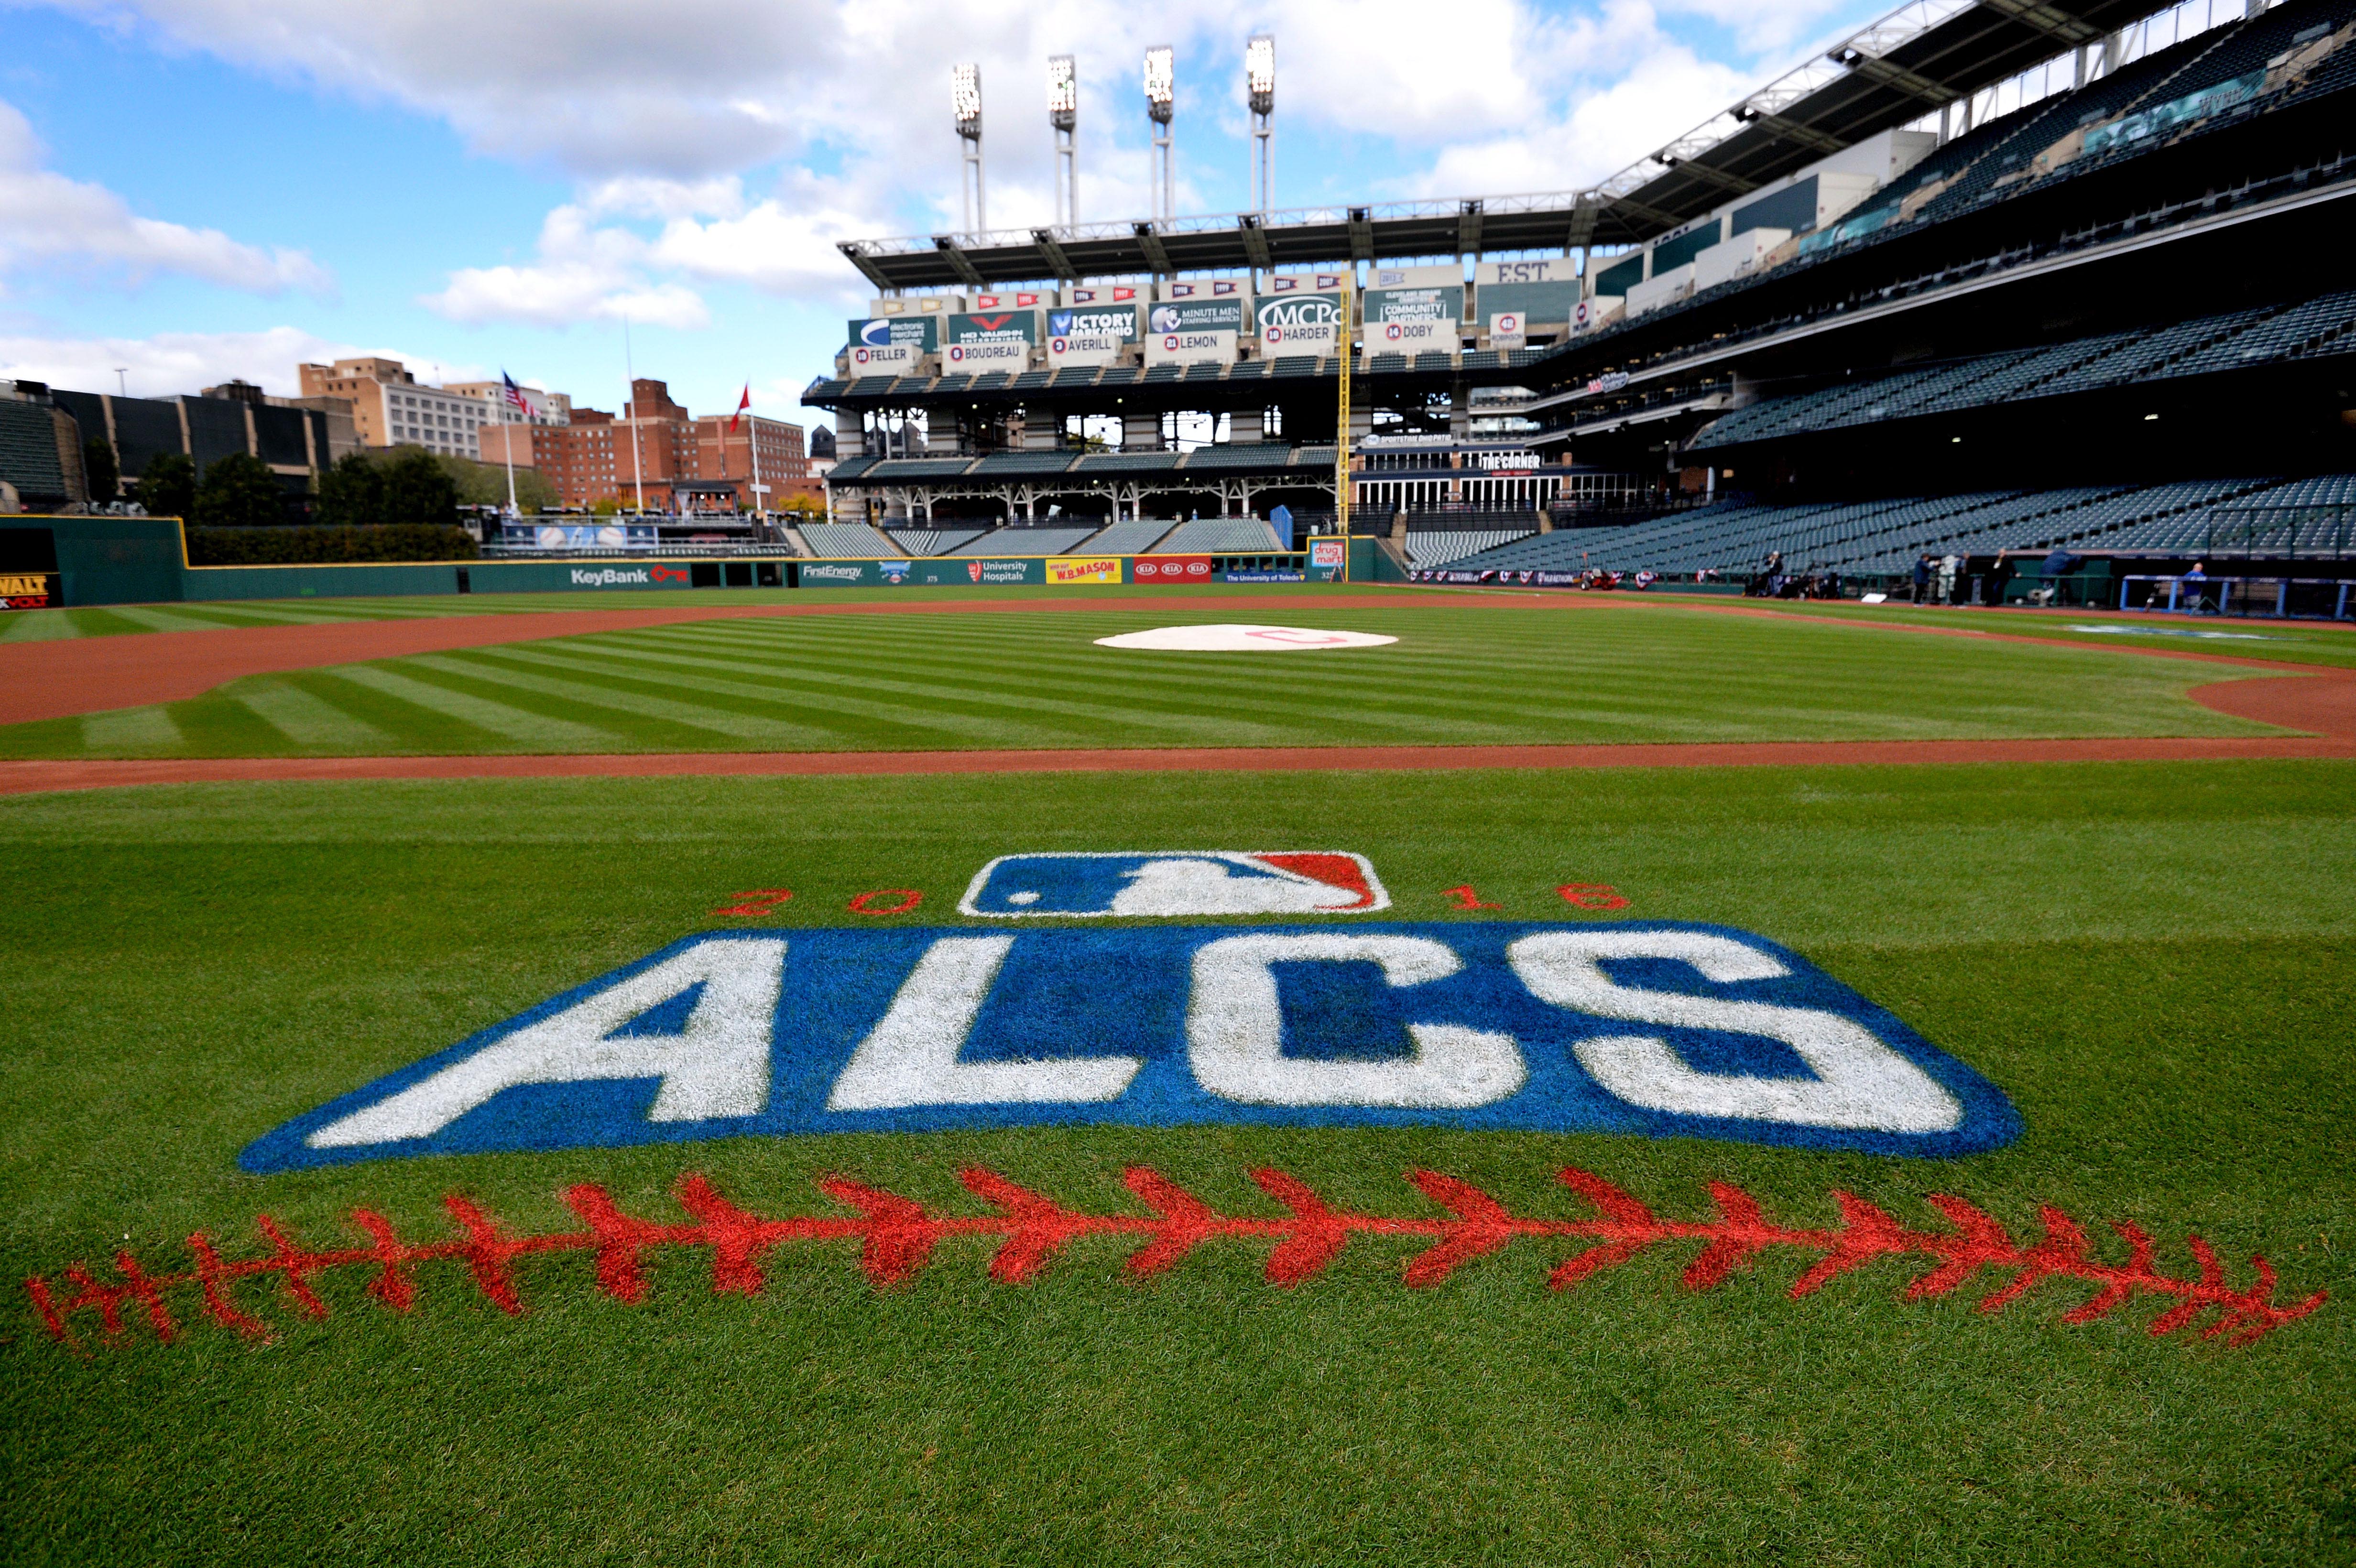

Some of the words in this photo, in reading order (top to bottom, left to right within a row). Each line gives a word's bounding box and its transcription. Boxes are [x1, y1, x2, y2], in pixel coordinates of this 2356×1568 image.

[1182, 308, 1217, 318] MINUTE
[1220, 307, 1239, 315] MEN
[1385, 304, 1441, 315] COMMUNITY
[1388, 314, 1437, 322] PARTNERS
[980, 329, 1023, 338] VAUGHN
[1284, 327, 1329, 340] HARDER
[1404, 325, 1433, 338] DOBY
[1068, 338, 1111, 351] AVERILL
[1180, 336, 1217, 348] LEMON
[871, 349, 906, 360] FELLER
[965, 346, 1019, 359] BOUDREAU
[1483, 456, 1500, 470] THE
[1502, 455, 1540, 469] CORNER
[1315, 543, 1338, 556] drug
[983, 561, 1026, 572] University
[1191, 564, 1205, 572] KIA
[571, 569, 648, 586] KeyBank
[983, 571, 1023, 582] Hospitals
[306, 930, 1963, 1148] ALCS
